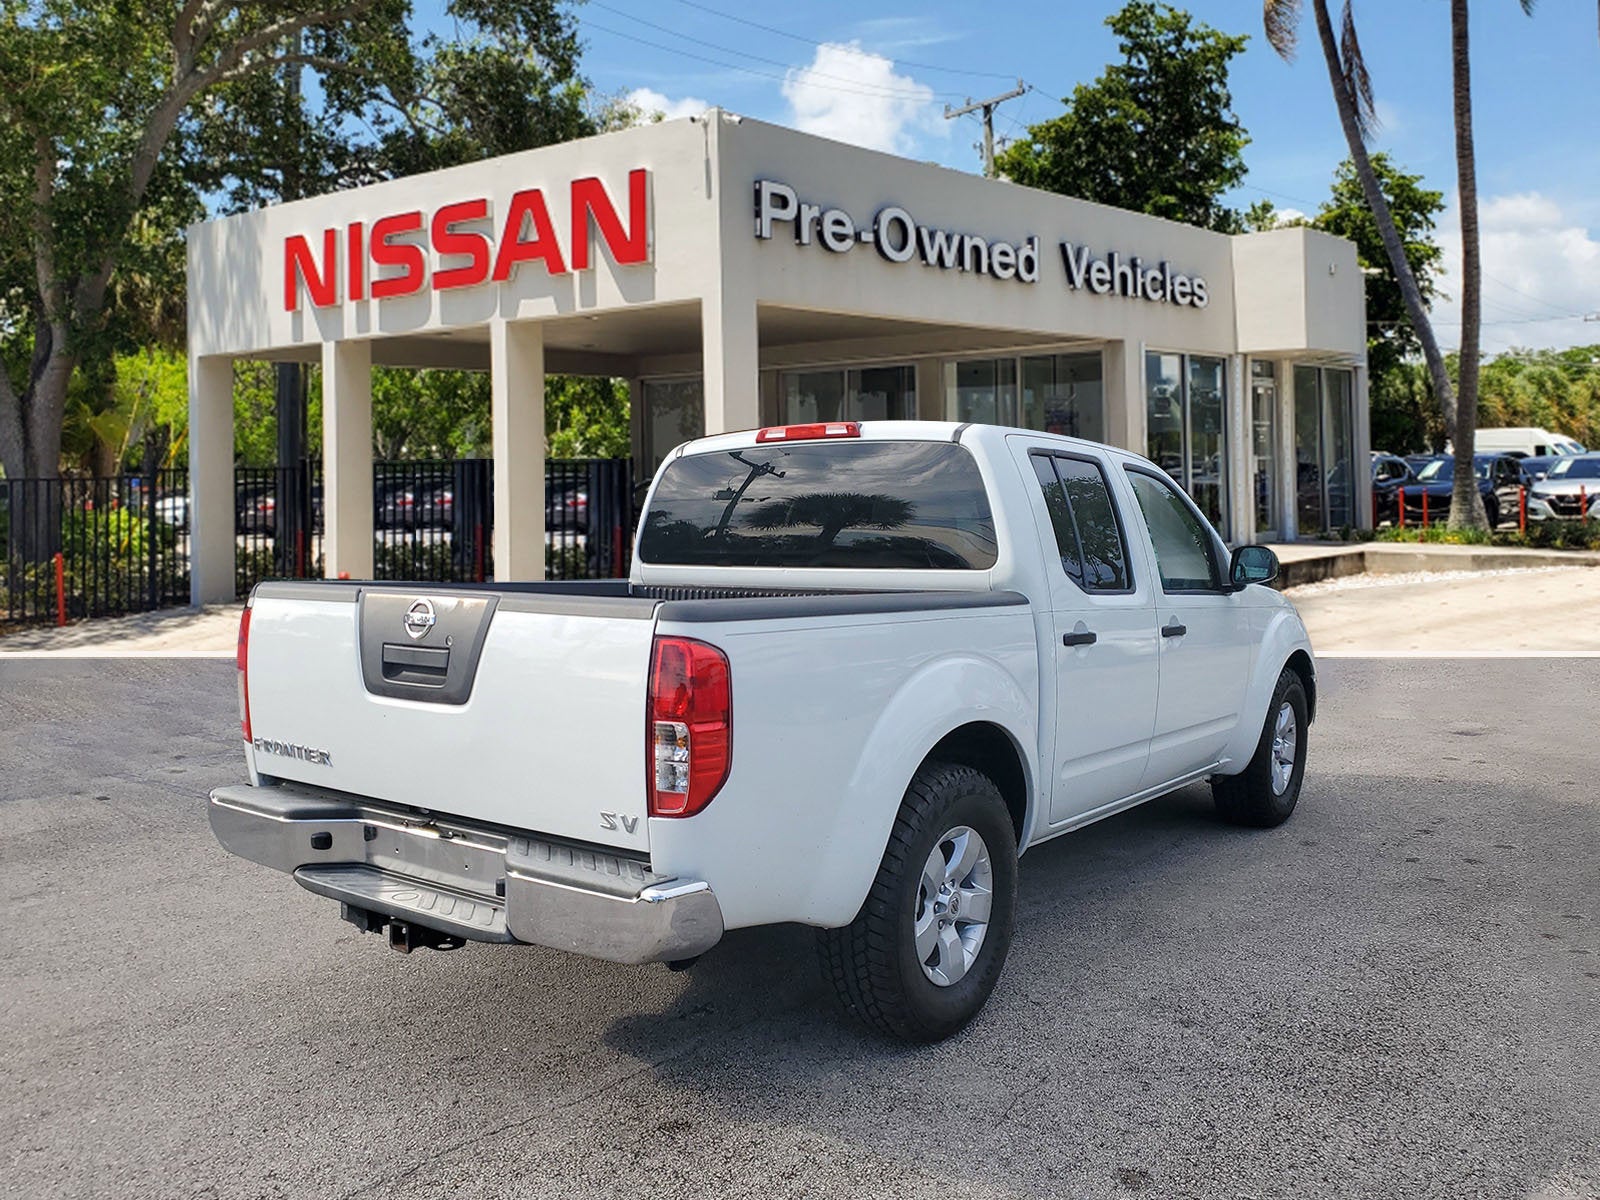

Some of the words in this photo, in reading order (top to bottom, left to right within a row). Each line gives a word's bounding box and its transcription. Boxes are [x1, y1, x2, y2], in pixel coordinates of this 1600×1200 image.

[284, 168, 649, 312] NISSAN
[754, 179, 1041, 283] Pre-Owned
[1060, 242, 1210, 309] Vehicles
[253, 736, 333, 768] FRONTIER
[600, 810, 640, 834] SV
